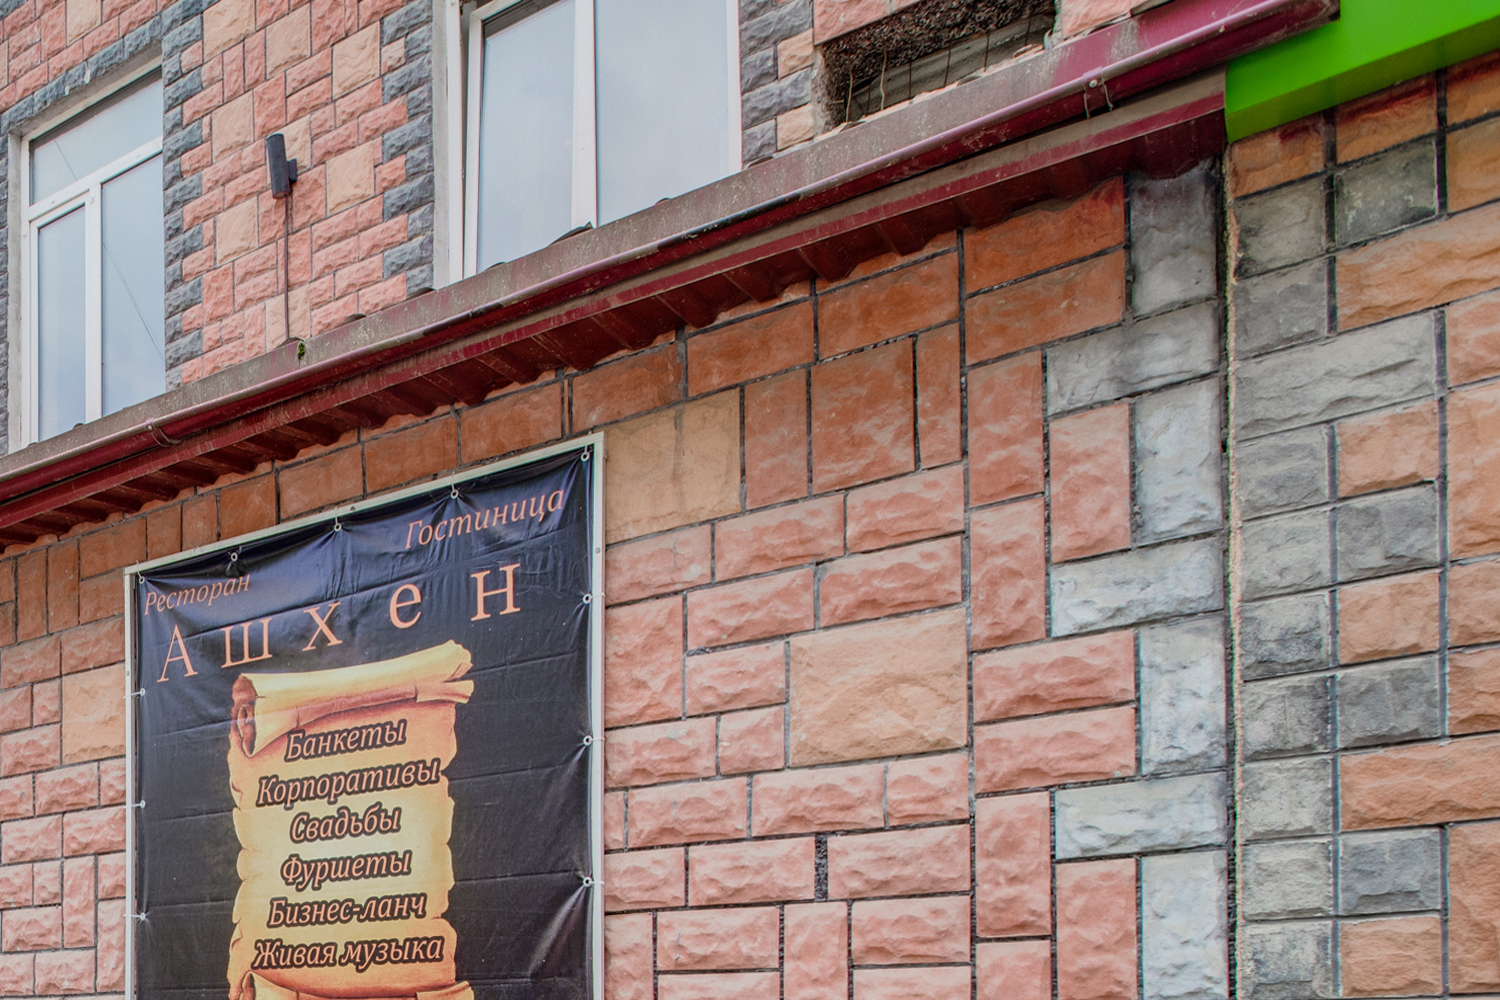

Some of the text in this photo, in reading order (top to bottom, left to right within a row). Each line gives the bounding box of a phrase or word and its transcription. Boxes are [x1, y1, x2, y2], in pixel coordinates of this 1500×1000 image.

[405, 489, 565, 549] Гостиница
[144, 574, 250, 615] Ресторан
[285, 721, 406, 761] Банкеты
[257, 760, 440, 809] Корпоративы
[291, 803, 401, 843] Свадьбы
[282, 852, 411, 890] Фуршеты
[269, 895, 425, 926] Бизнес-ланч
[253, 937, 443, 971] Живая музыка
